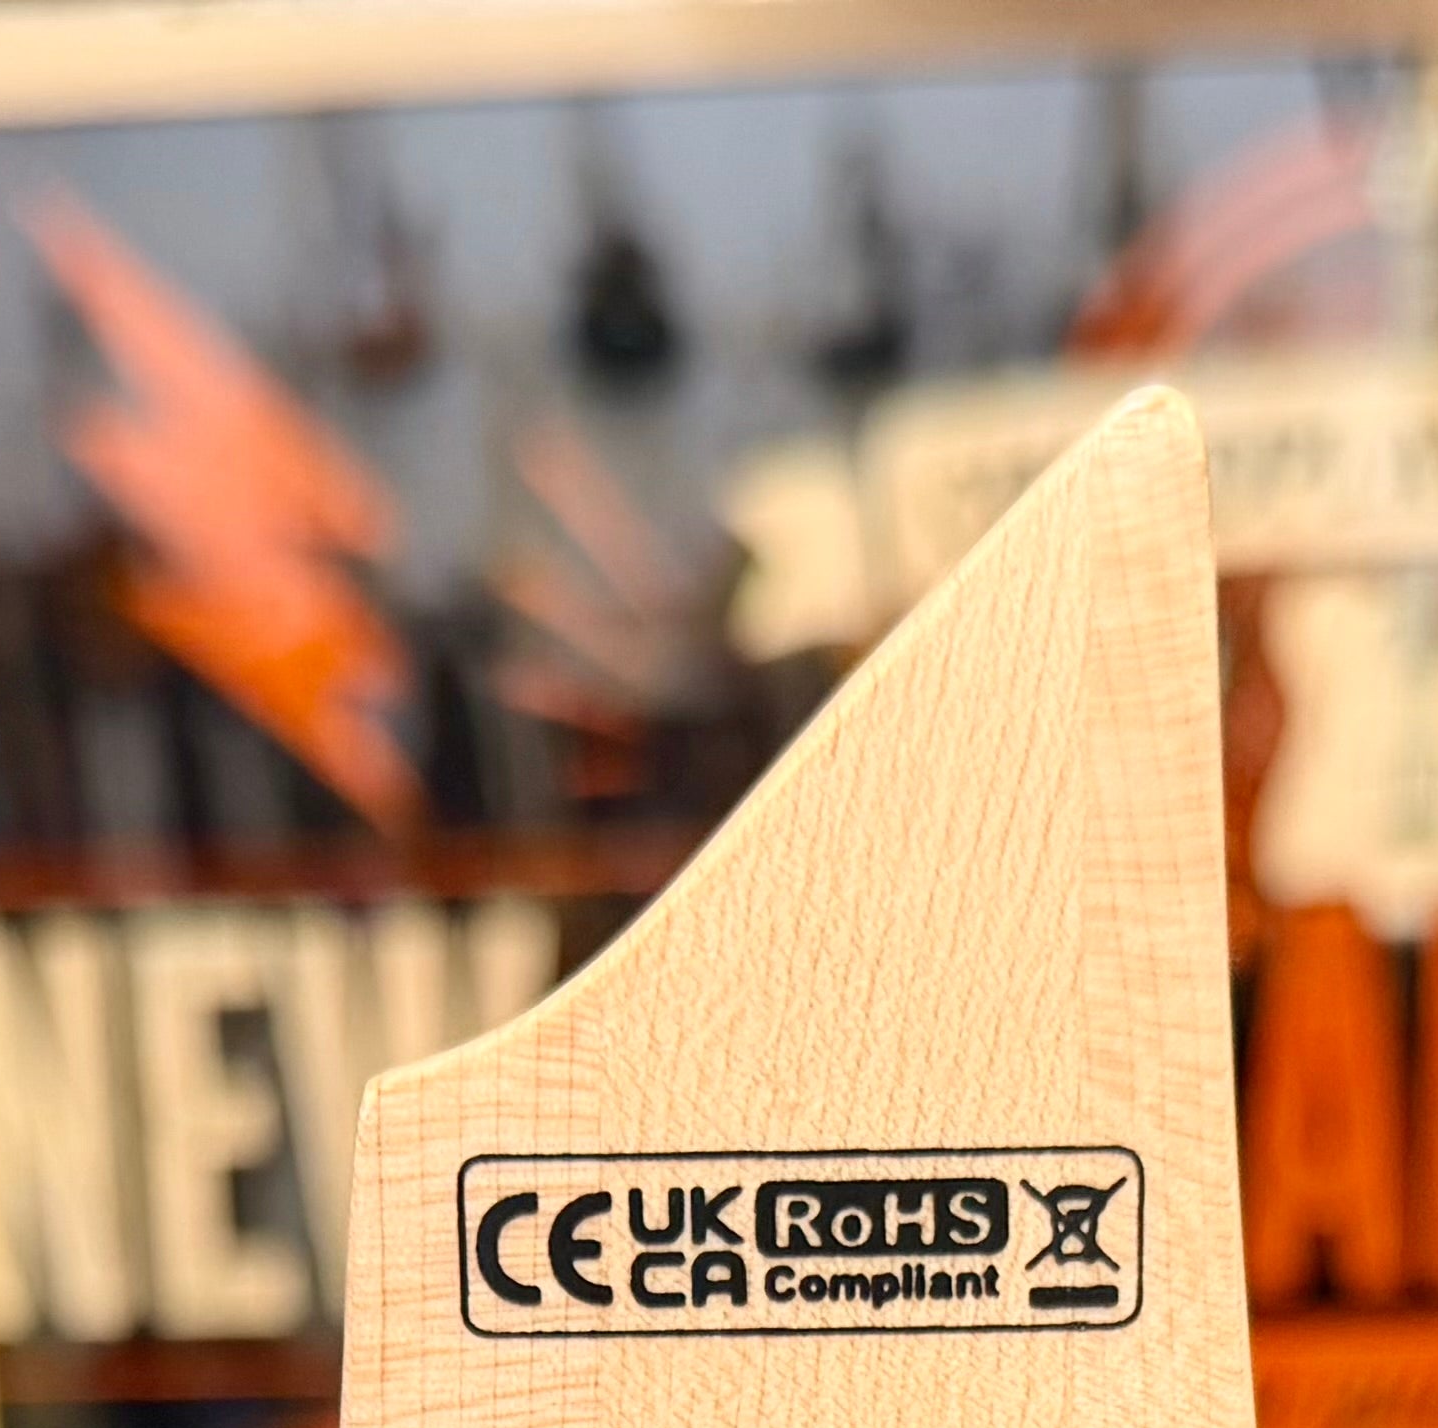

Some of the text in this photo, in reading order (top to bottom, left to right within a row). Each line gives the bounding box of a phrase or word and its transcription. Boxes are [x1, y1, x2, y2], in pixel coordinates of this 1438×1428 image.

[627, 1184, 745, 1246] UK
[773, 1189, 992, 1250] RoHS
[475, 1190, 614, 1307] CE
[629, 1249, 748, 1309] CA
[764, 1261, 1001, 1311] Compliant
